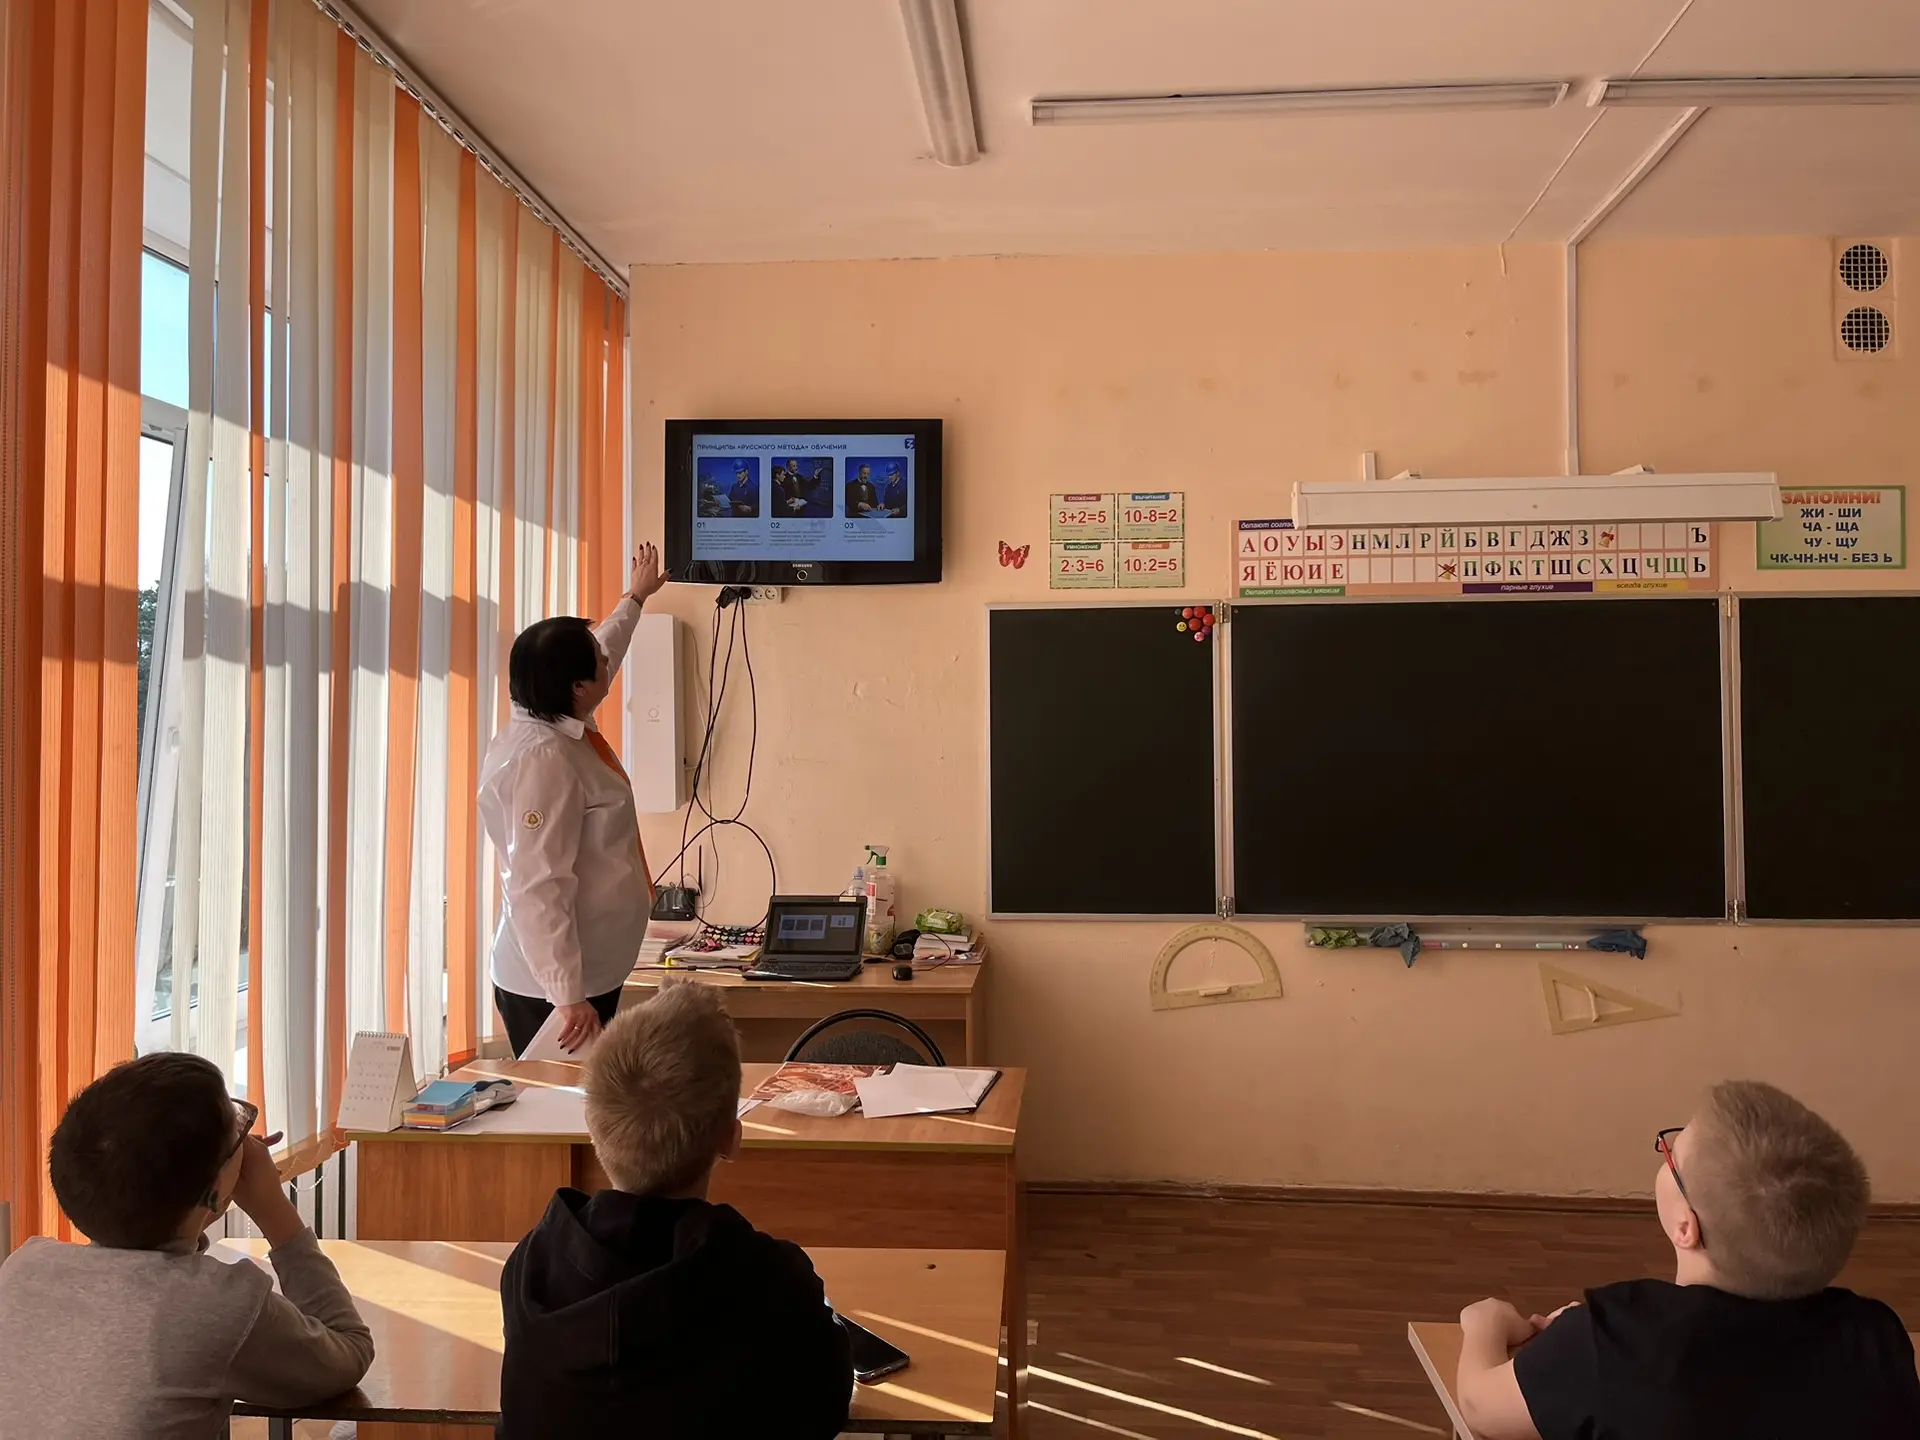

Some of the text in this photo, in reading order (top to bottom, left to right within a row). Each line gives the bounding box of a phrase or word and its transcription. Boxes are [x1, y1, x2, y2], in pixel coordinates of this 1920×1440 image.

[1782, 492, 1881, 504] ЗАПОМНИ!
[1800, 508, 1825, 518] ЖИ
[1838, 508, 1862, 518] ШИ
[1803, 522, 1822, 532] ЧА
[1835, 522, 1859, 533] ЩА
[1804, 538, 1822, 547] ЧУ
[1835, 538, 1858, 548] ЩУ
[1770, 553, 1839, 563] ЧК-ЧН-НЧ
[1851, 553, 1879, 563] БЕЗ
[1883, 553, 1893, 563] Ь
